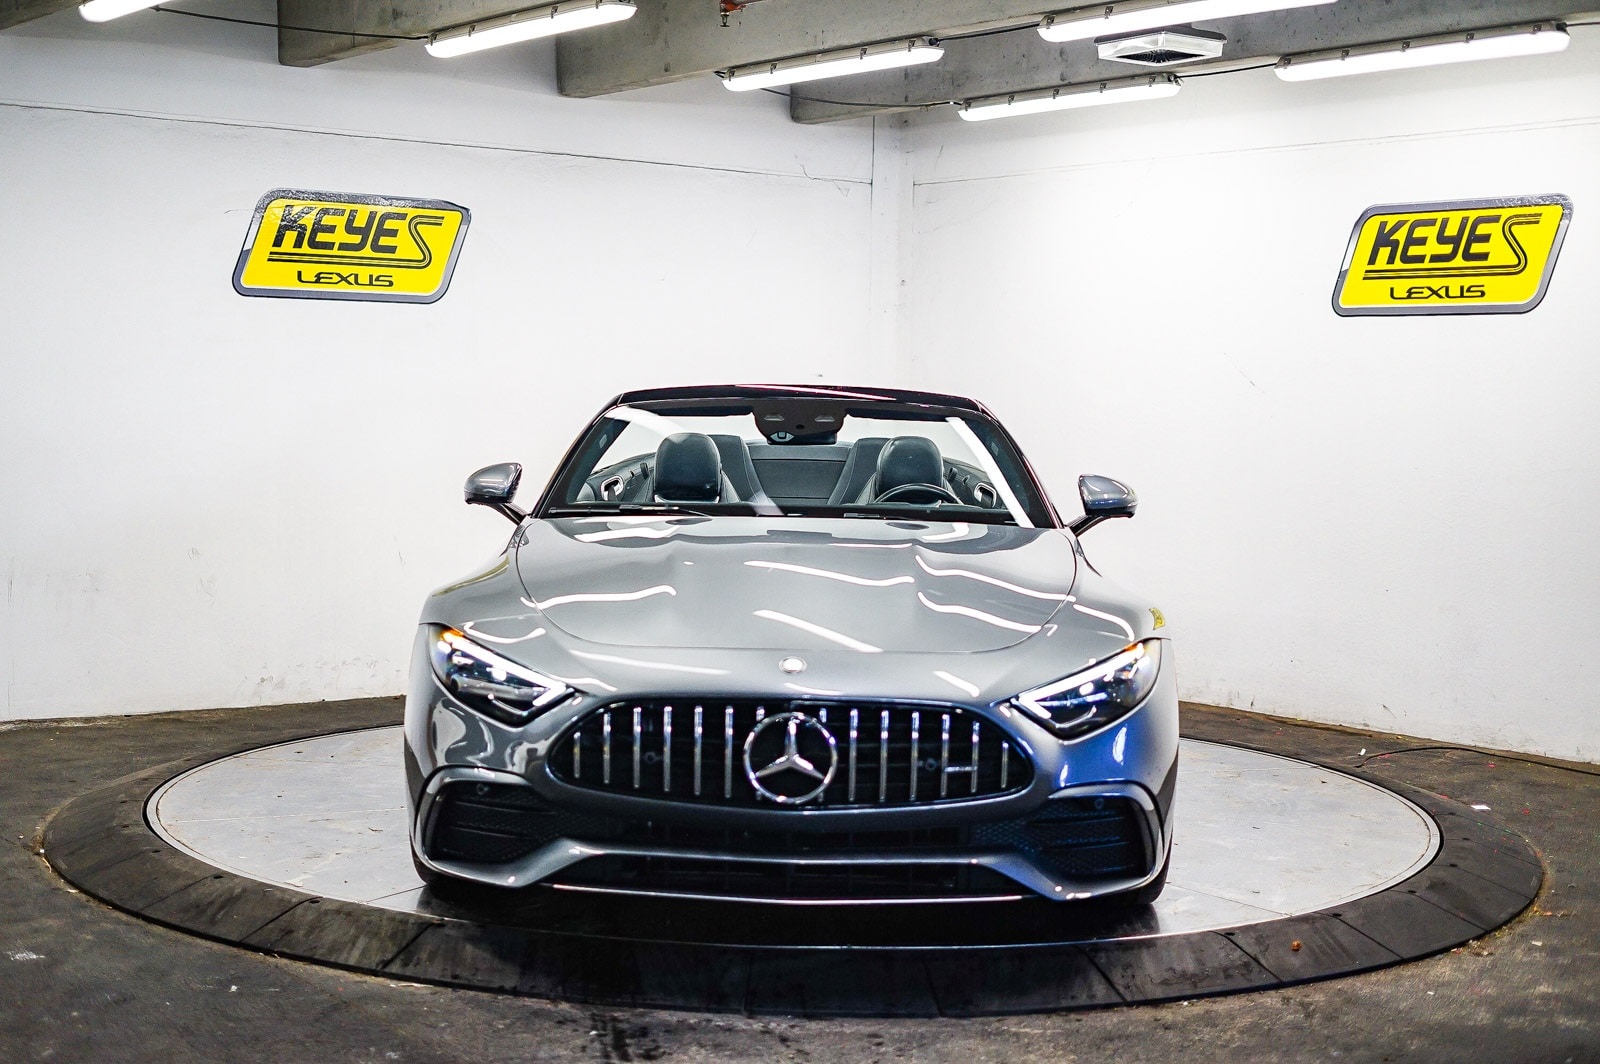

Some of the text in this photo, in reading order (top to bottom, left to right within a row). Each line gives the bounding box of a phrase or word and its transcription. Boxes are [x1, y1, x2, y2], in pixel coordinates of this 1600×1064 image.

[270, 204, 445, 269] KEYES
[1365, 213, 1542, 278] KEYES
[297, 270, 394, 288] LEXUS
[1389, 284, 1486, 300] LEXUS
